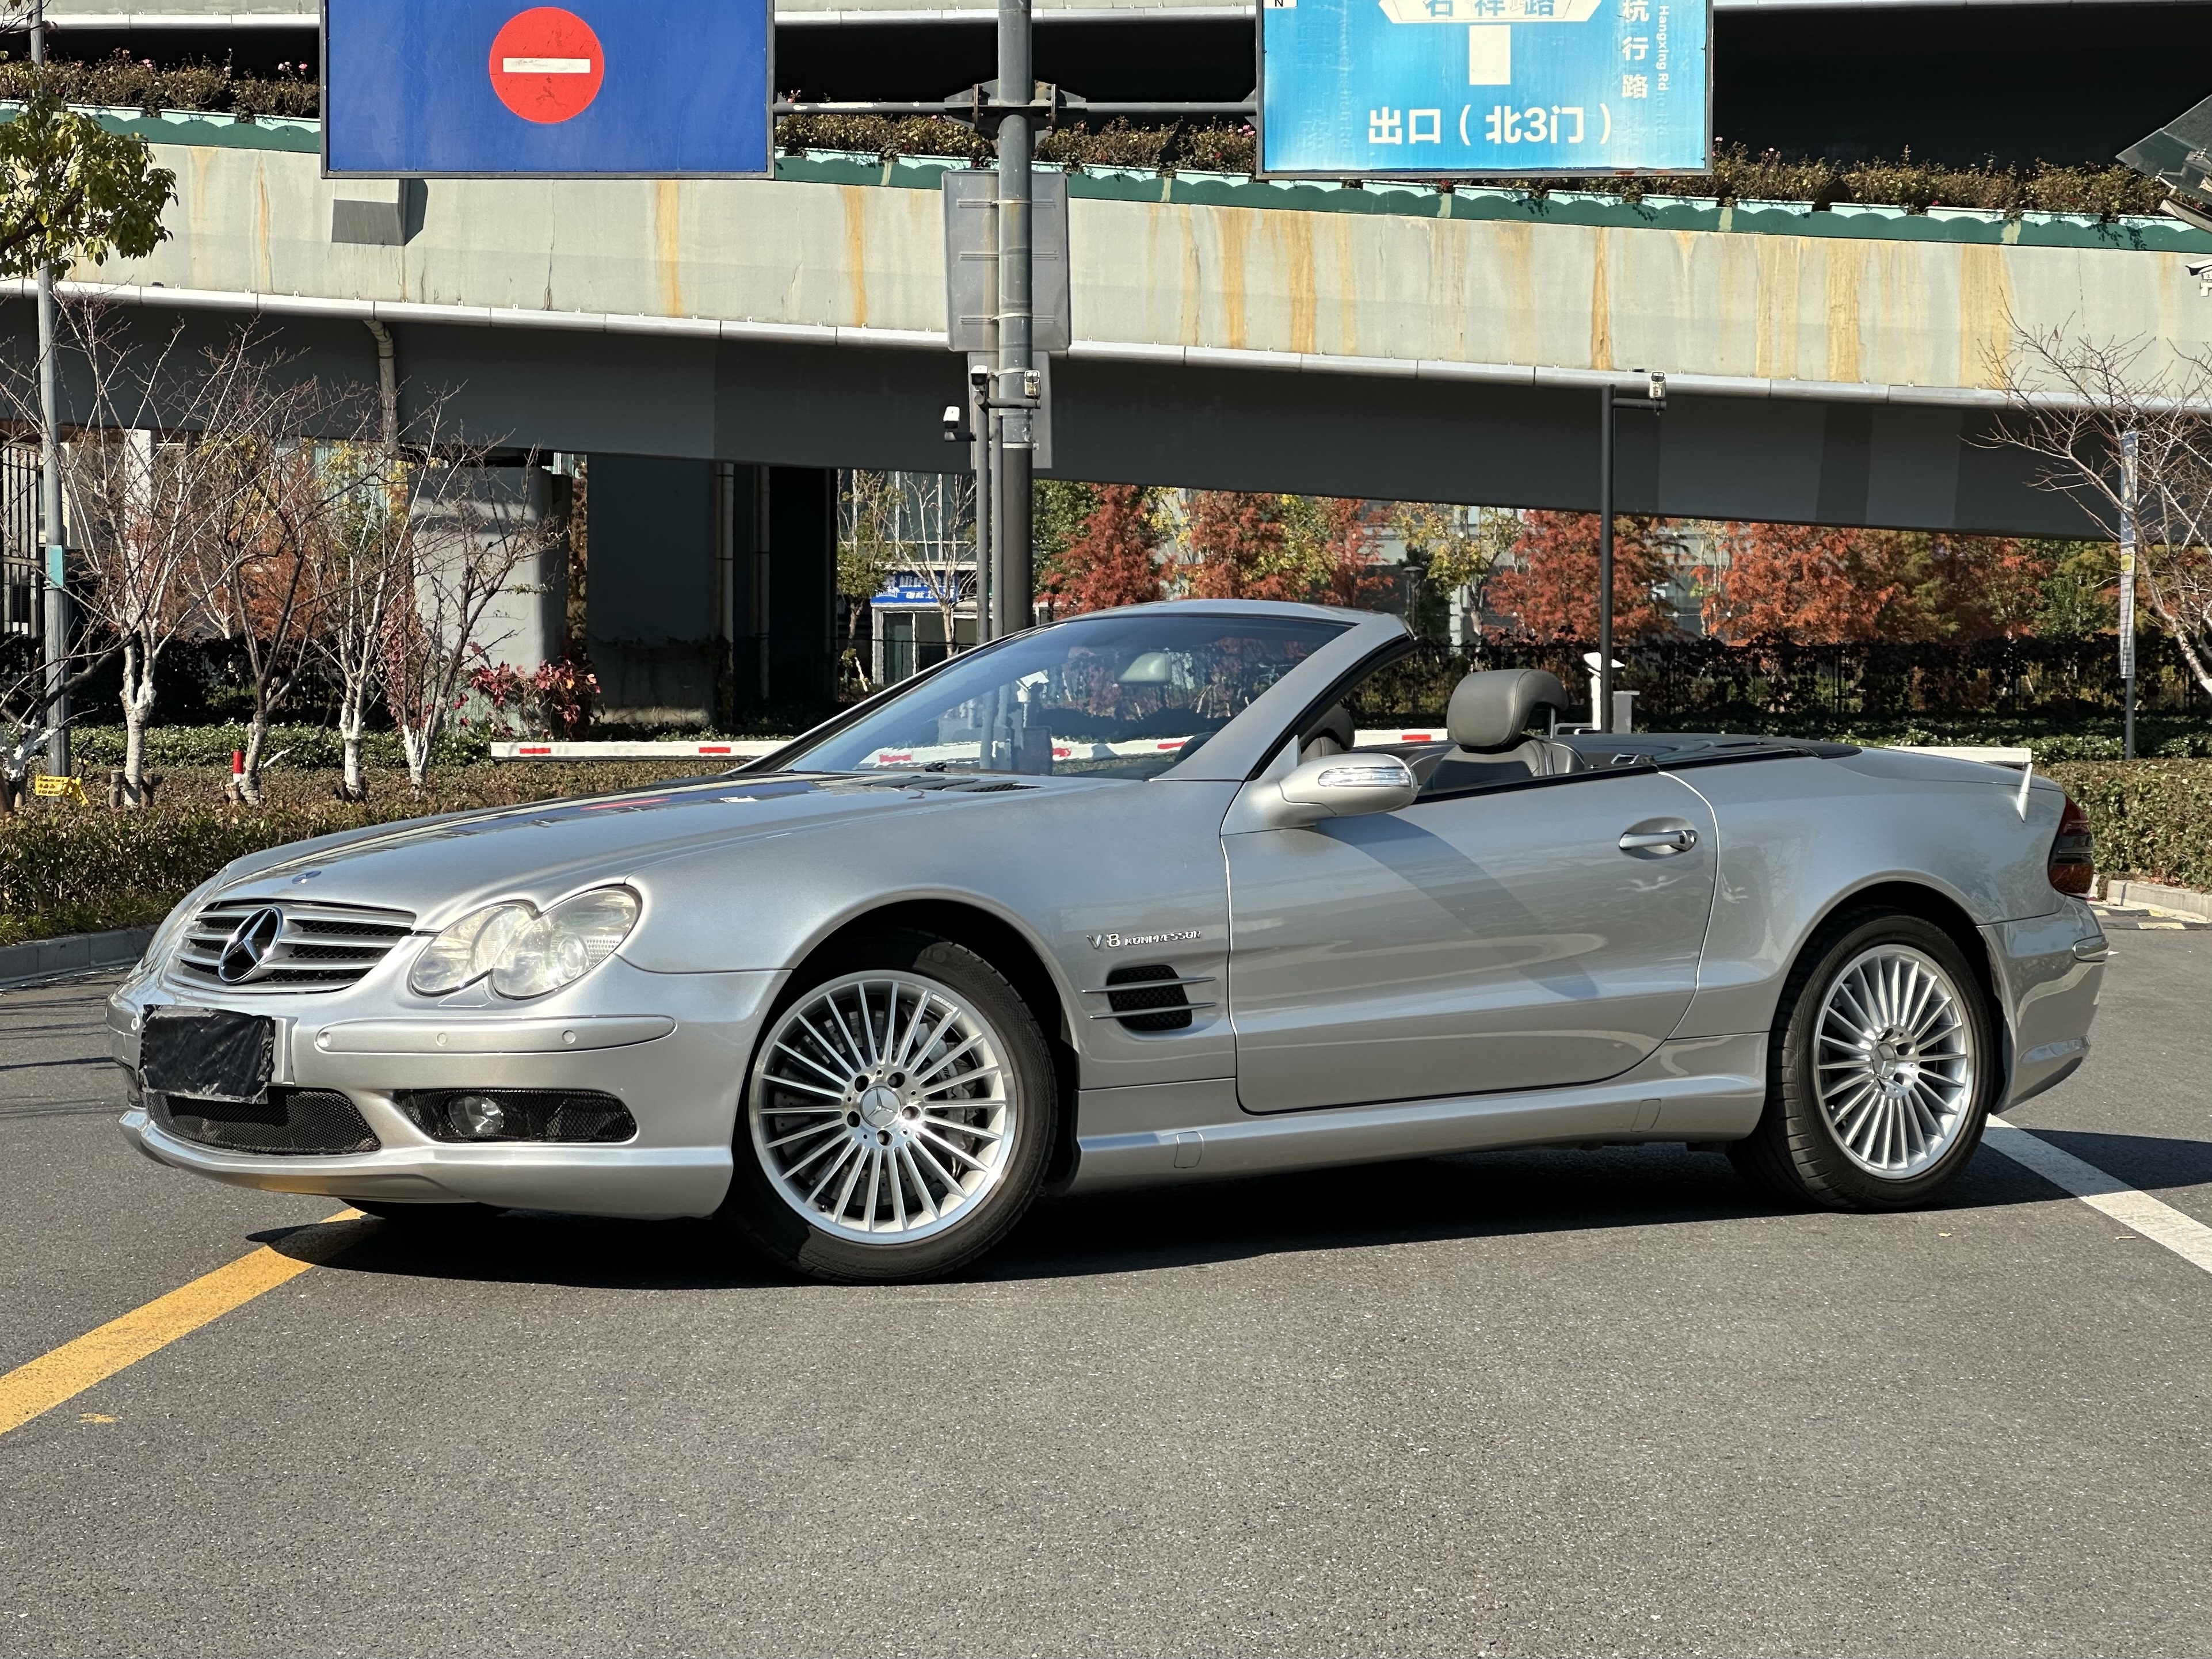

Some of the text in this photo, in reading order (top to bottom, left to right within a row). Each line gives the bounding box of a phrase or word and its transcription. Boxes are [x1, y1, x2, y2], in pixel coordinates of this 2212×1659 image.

[1656, 6, 1670, 70] Hangxing
[1658, 73, 1669, 91] Rd
[1086, 930, 1201, 949] V8 KOMPRESSOR
